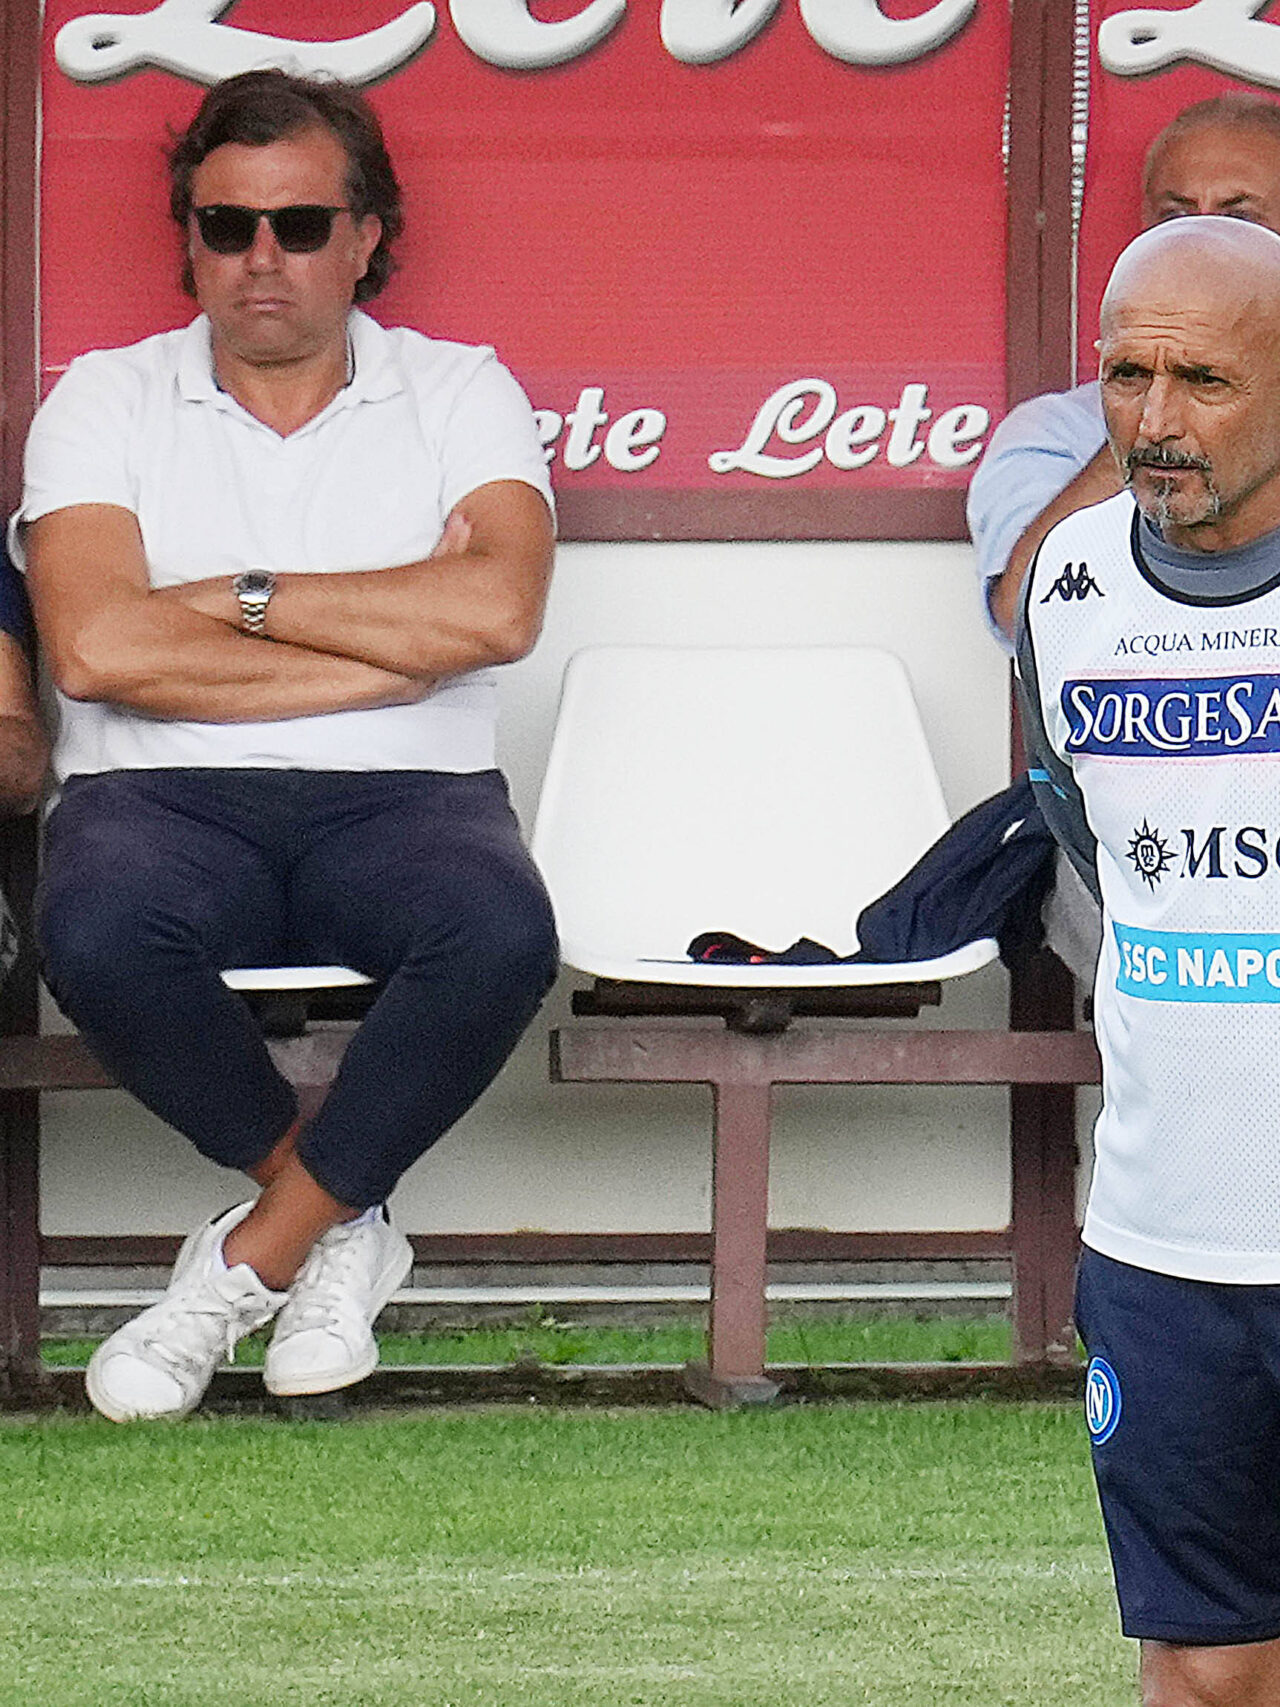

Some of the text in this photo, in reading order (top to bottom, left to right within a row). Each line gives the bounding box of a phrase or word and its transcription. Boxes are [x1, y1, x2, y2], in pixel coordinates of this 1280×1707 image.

[532, 386, 668, 472] te
[707, 378, 990, 478] Lete
[1114, 633, 1194, 656] ACQUA
[1122, 940, 1169, 985] SSC
[1090, 1380, 1106, 1423] N
